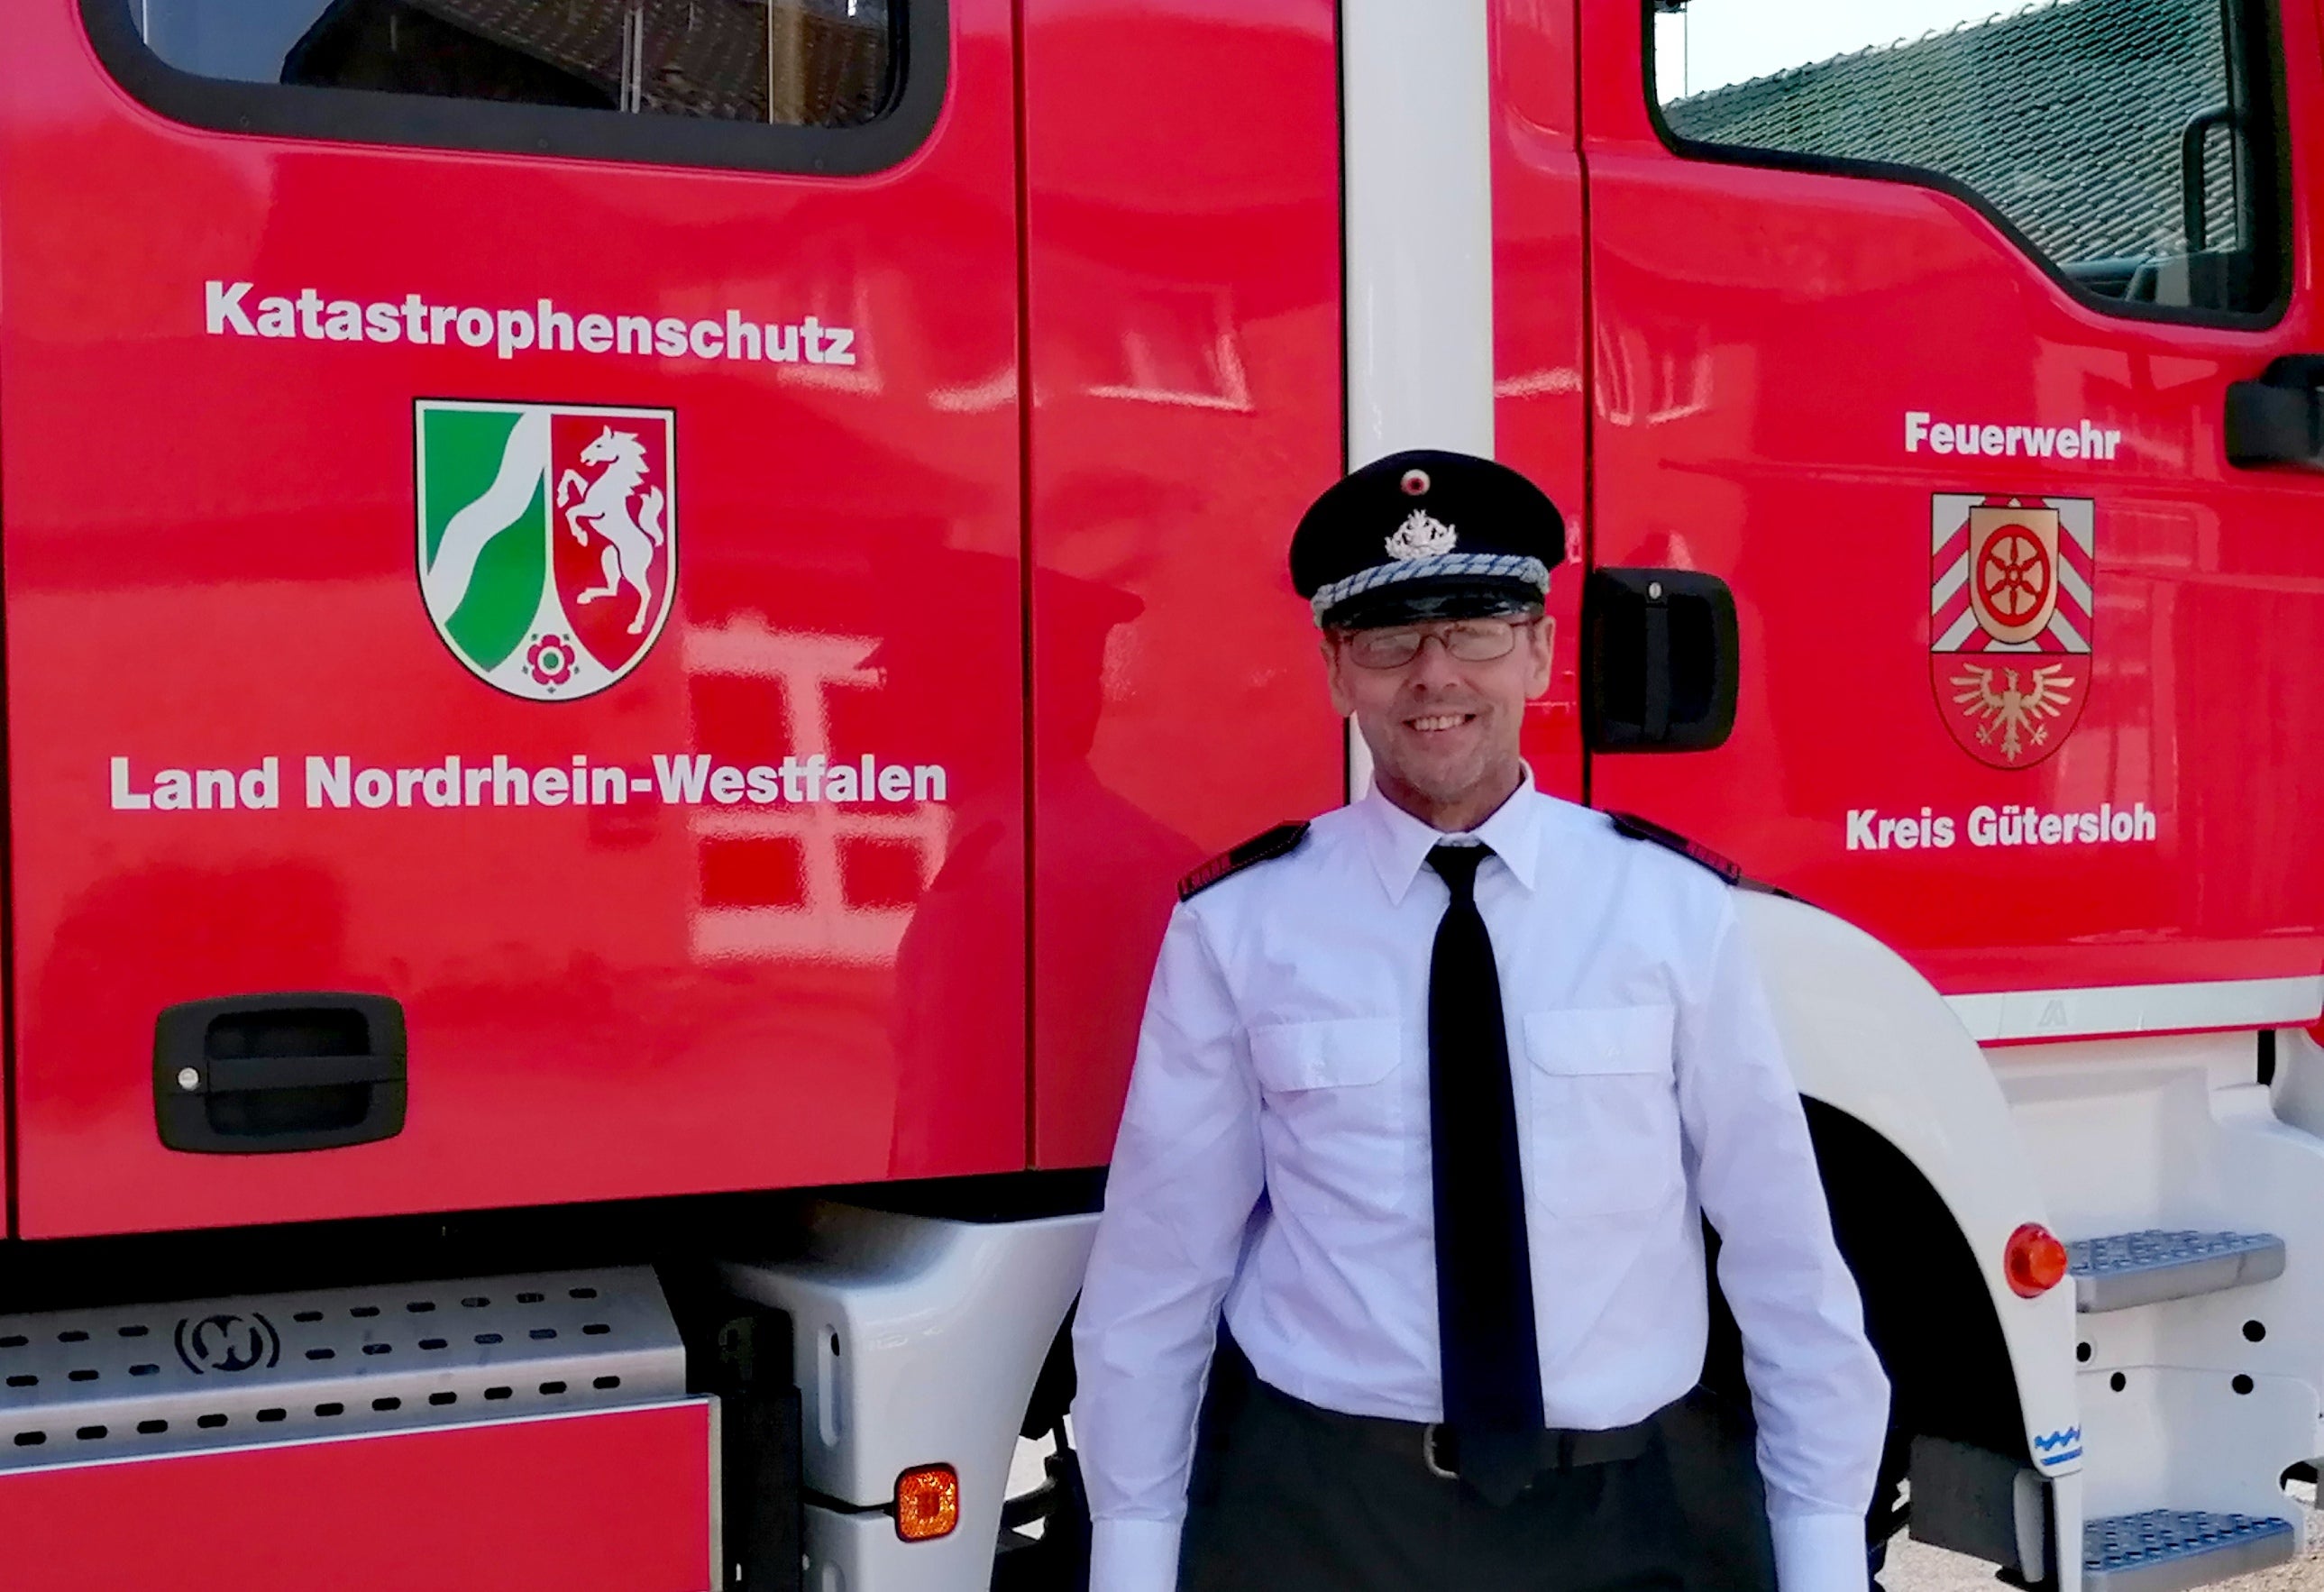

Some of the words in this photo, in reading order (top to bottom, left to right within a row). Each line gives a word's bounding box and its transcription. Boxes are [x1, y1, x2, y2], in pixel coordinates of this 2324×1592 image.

[205, 280, 856, 365] Katastrophenschutz
[1905, 411, 2121, 460] Feuerwehr
[110, 756, 279, 810] Land
[305, 754, 947, 809] Nordrhein-Westfalen
[1846, 807, 1956, 850] Kreis
[1966, 801, 2156, 846] Gütersloh
